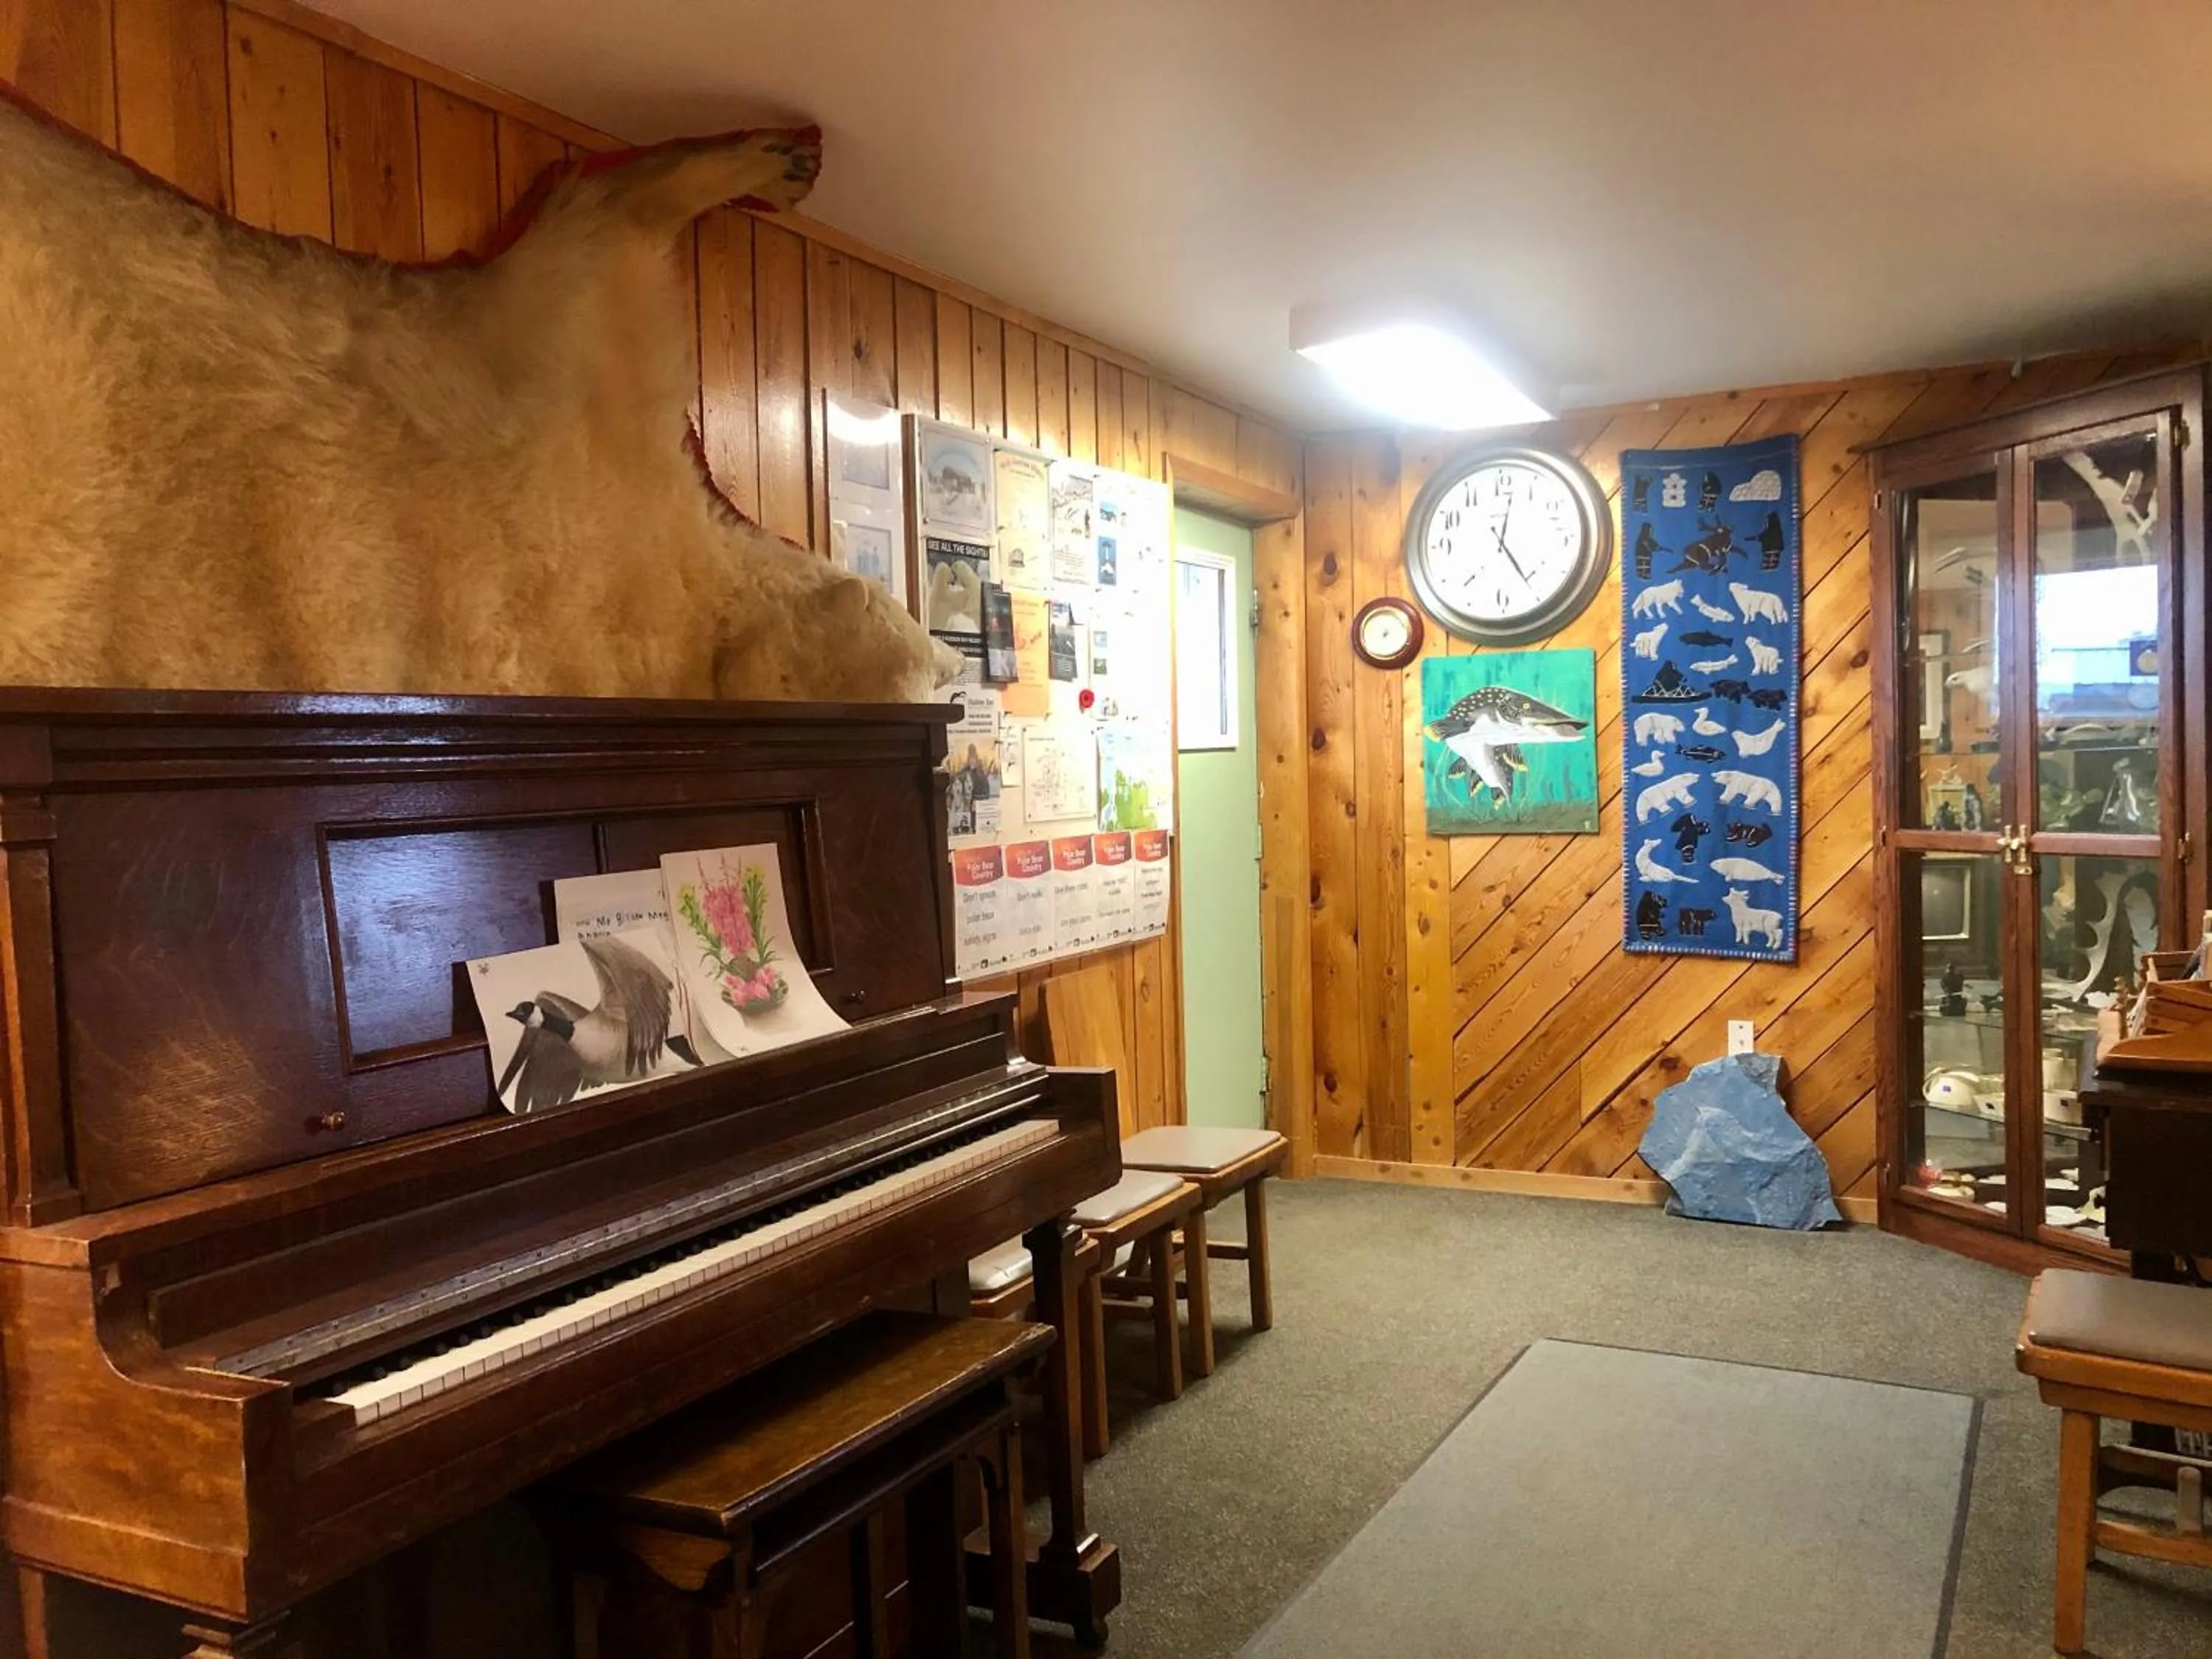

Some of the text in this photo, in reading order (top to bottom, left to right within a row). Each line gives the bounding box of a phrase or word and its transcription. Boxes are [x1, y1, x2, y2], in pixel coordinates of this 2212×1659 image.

[1495, 475, 1512, 496] 12
[1466, 486, 1477, 507] 11
[1445, 509, 1460, 530] 10
[928, 540, 939, 551] SEE
[941, 542, 952, 552] ALL
[953, 543, 965, 554] THE
[1439, 537, 1452, 555] 9
[1017, 854, 1043, 865] Polar Bear
[1076, 849, 1086, 857] Bear
[967, 860, 995, 873] Polar Bear
